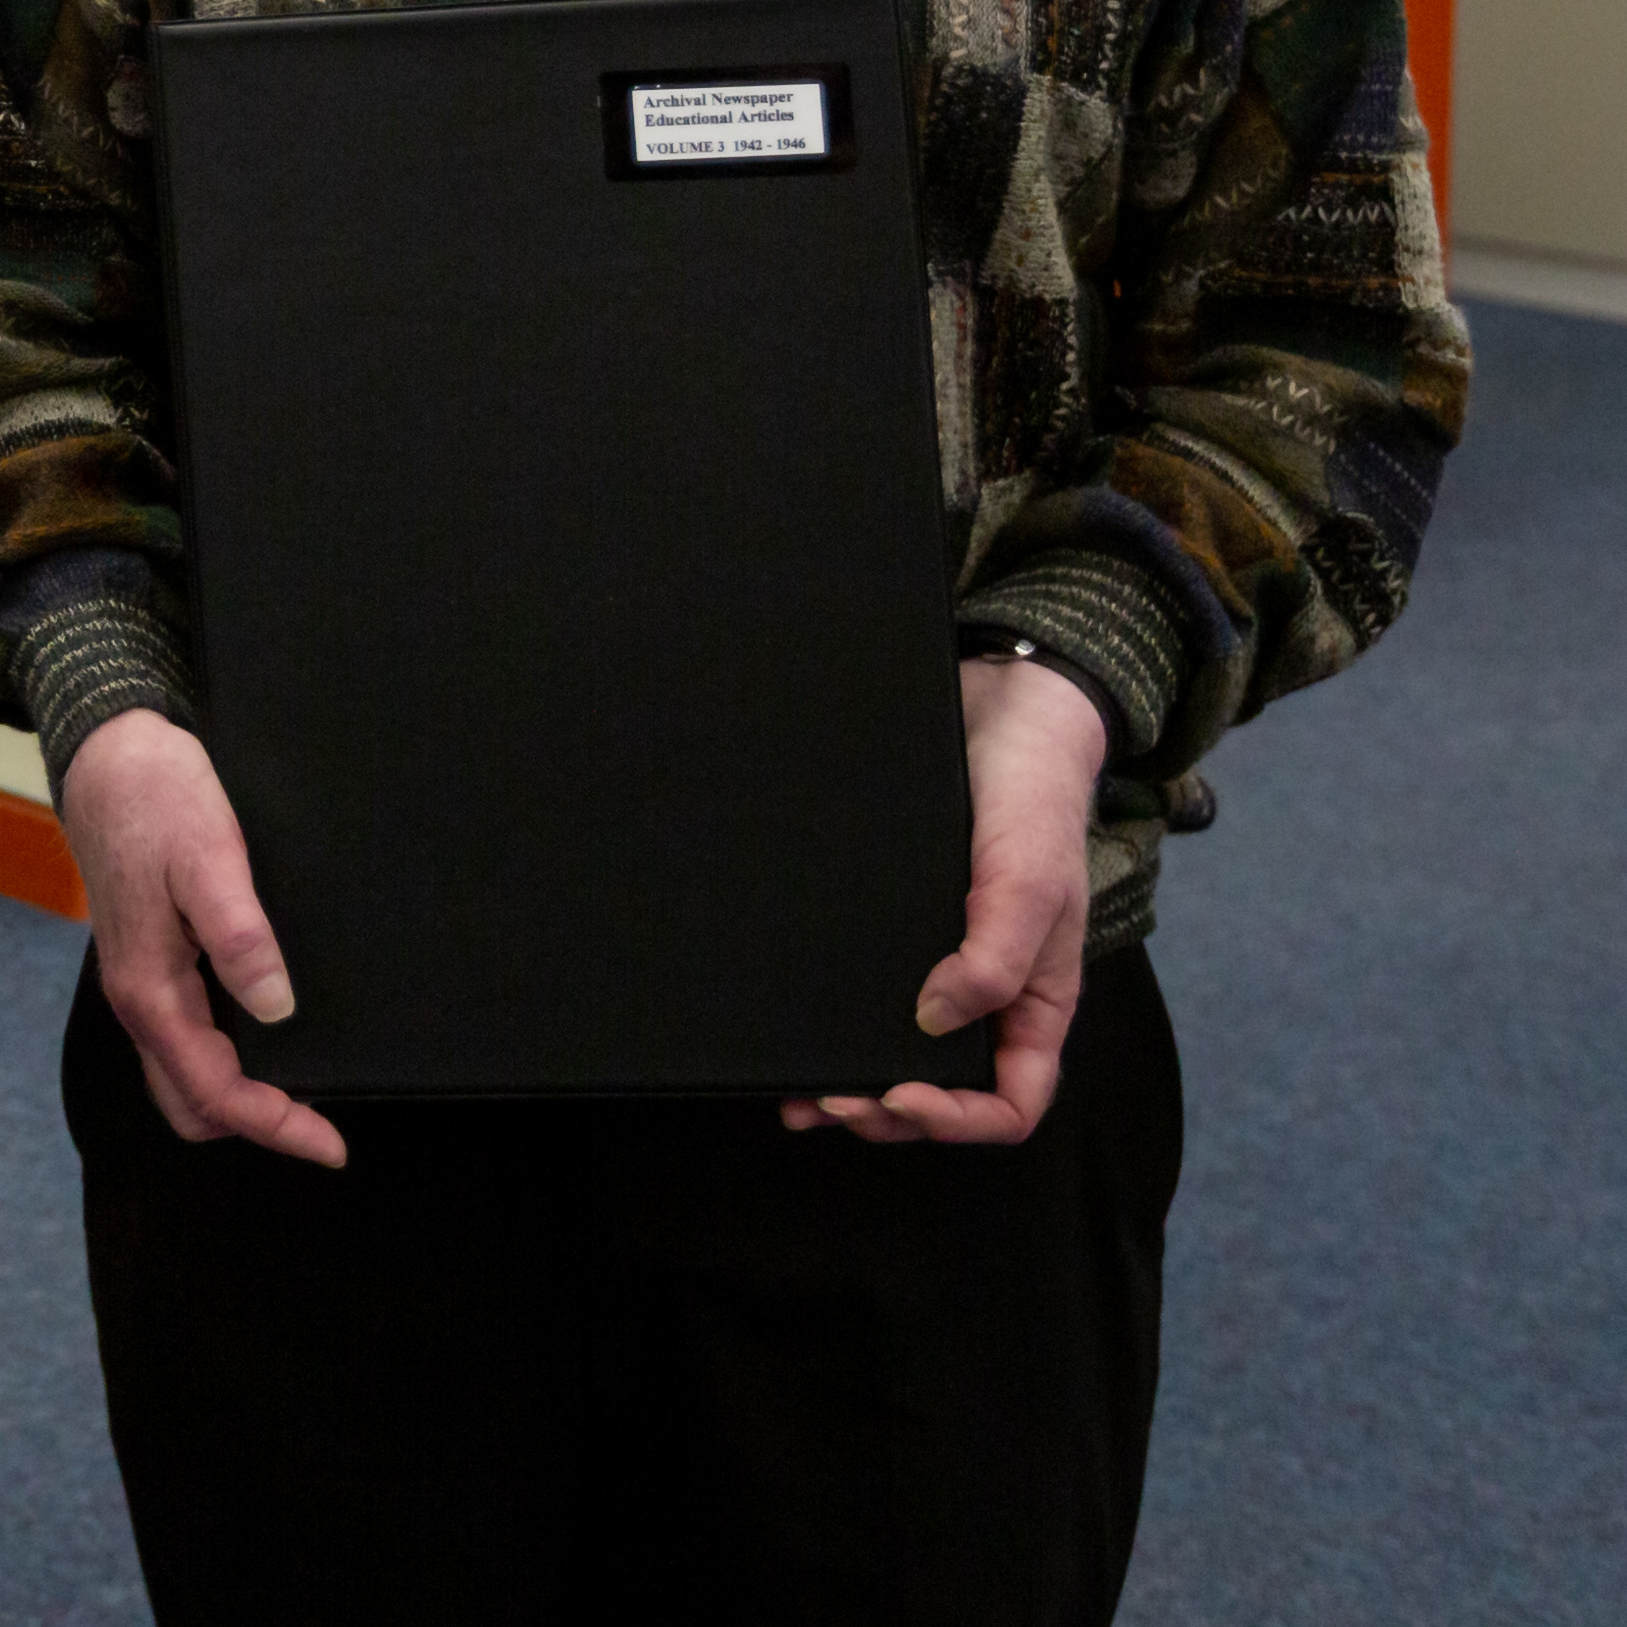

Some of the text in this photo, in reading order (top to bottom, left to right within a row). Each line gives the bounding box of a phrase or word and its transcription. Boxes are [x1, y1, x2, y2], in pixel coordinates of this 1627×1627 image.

[643, 92, 793, 108] Archival Newspaper
[645, 109, 794, 127] Educational Articles
[646, 141, 713, 154] VOLUME
[717, 141, 725, 152] 3
[734, 140, 762, 152] 1942
[777, 139, 806, 150] 1946
